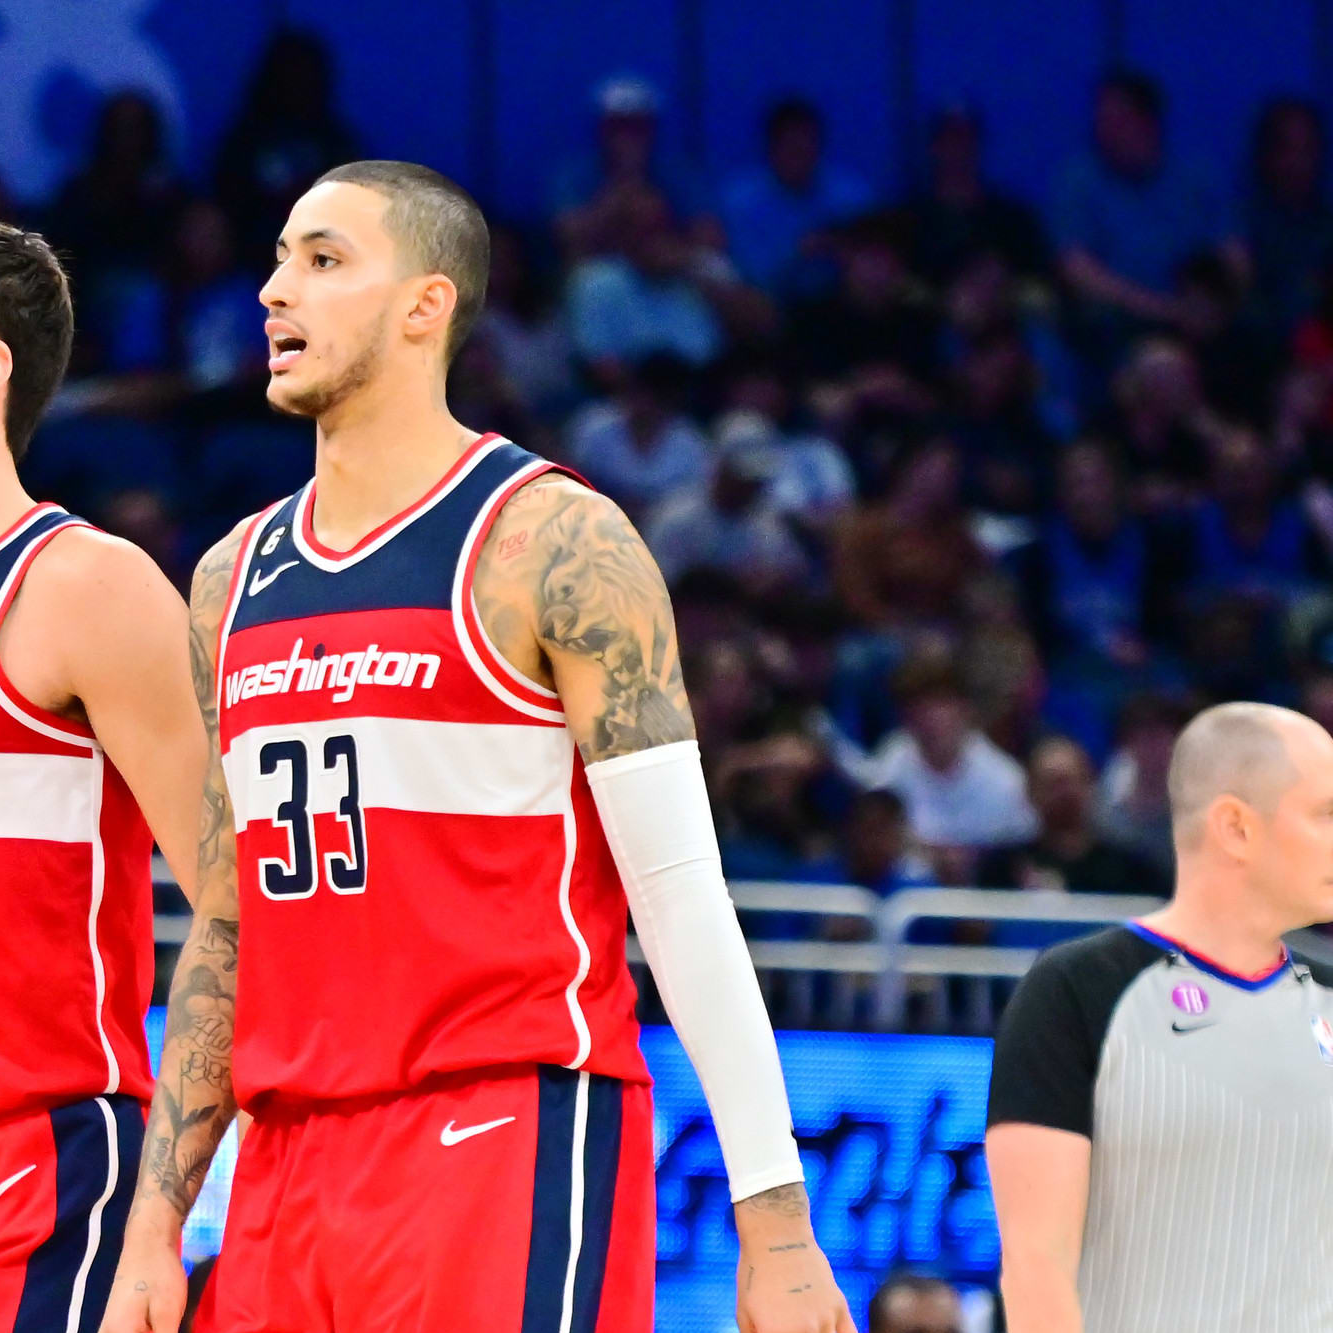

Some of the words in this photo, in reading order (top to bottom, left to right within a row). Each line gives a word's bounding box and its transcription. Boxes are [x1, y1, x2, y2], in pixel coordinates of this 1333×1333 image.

[261, 526, 286, 556] 6
[226, 637, 441, 709] washington
[259, 734, 367, 901] 33
